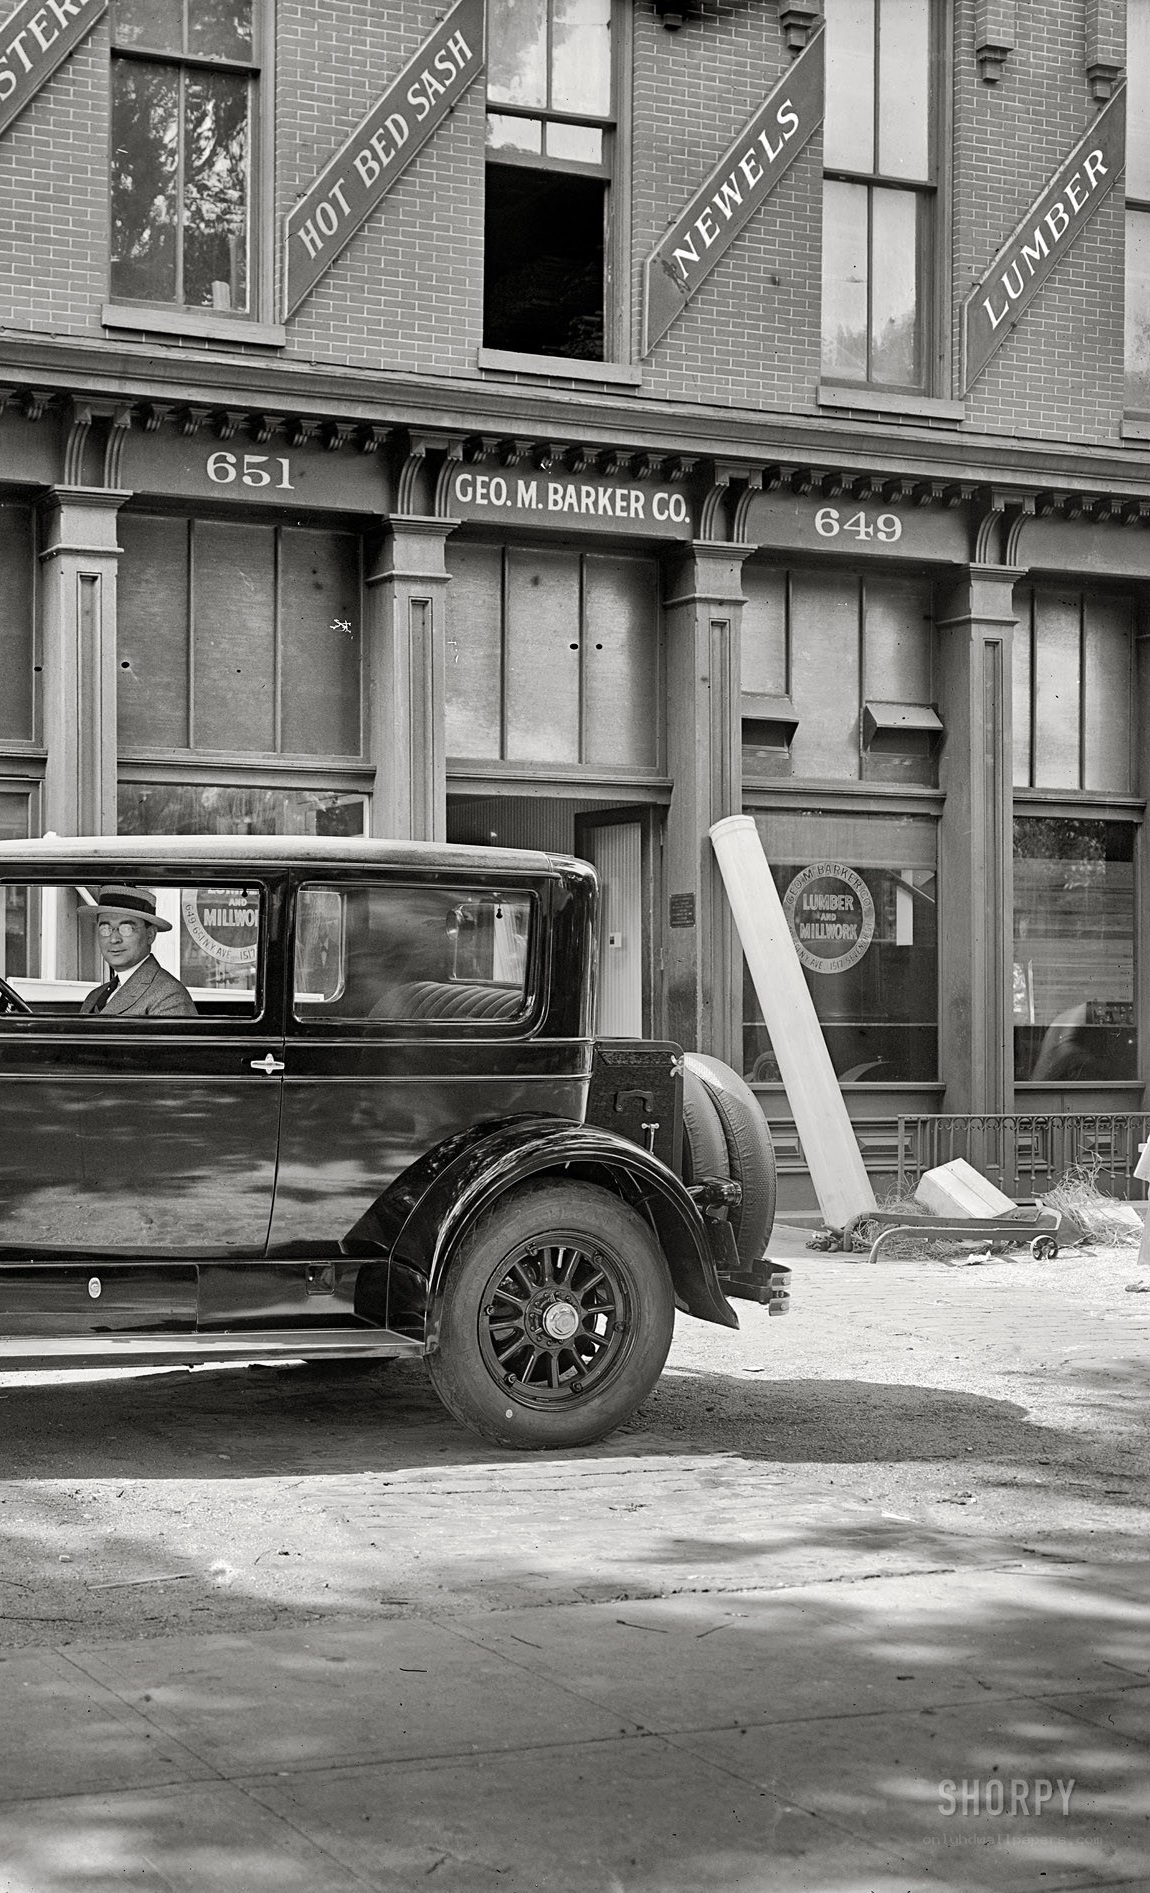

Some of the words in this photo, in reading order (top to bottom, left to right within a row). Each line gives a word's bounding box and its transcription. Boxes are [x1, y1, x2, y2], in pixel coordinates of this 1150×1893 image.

[297, 177, 351, 259] HOT
[352, 113, 410, 189] BED
[406, 29, 473, 122] SASH
[672, 98, 799, 280] NEWELS
[983, 149, 1109, 331] LUMBER
[206, 451, 295, 489] 651
[455, 473, 512, 507] GEO.
[517, 479, 544, 510] M.
[548, 482, 645, 519] BARKER
[652, 492, 691, 524] CO.
[814, 507, 902, 542] 649
[816, 864, 861, 890] BARKER
[228, 897, 248, 907] AND
[802, 893, 854, 911] LUMBER
[820, 912, 837, 922] AND
[800, 922, 858, 940] MILLWORK
[239, 948, 256, 961] 1517
[845, 934, 870, 964] SEVENTH
